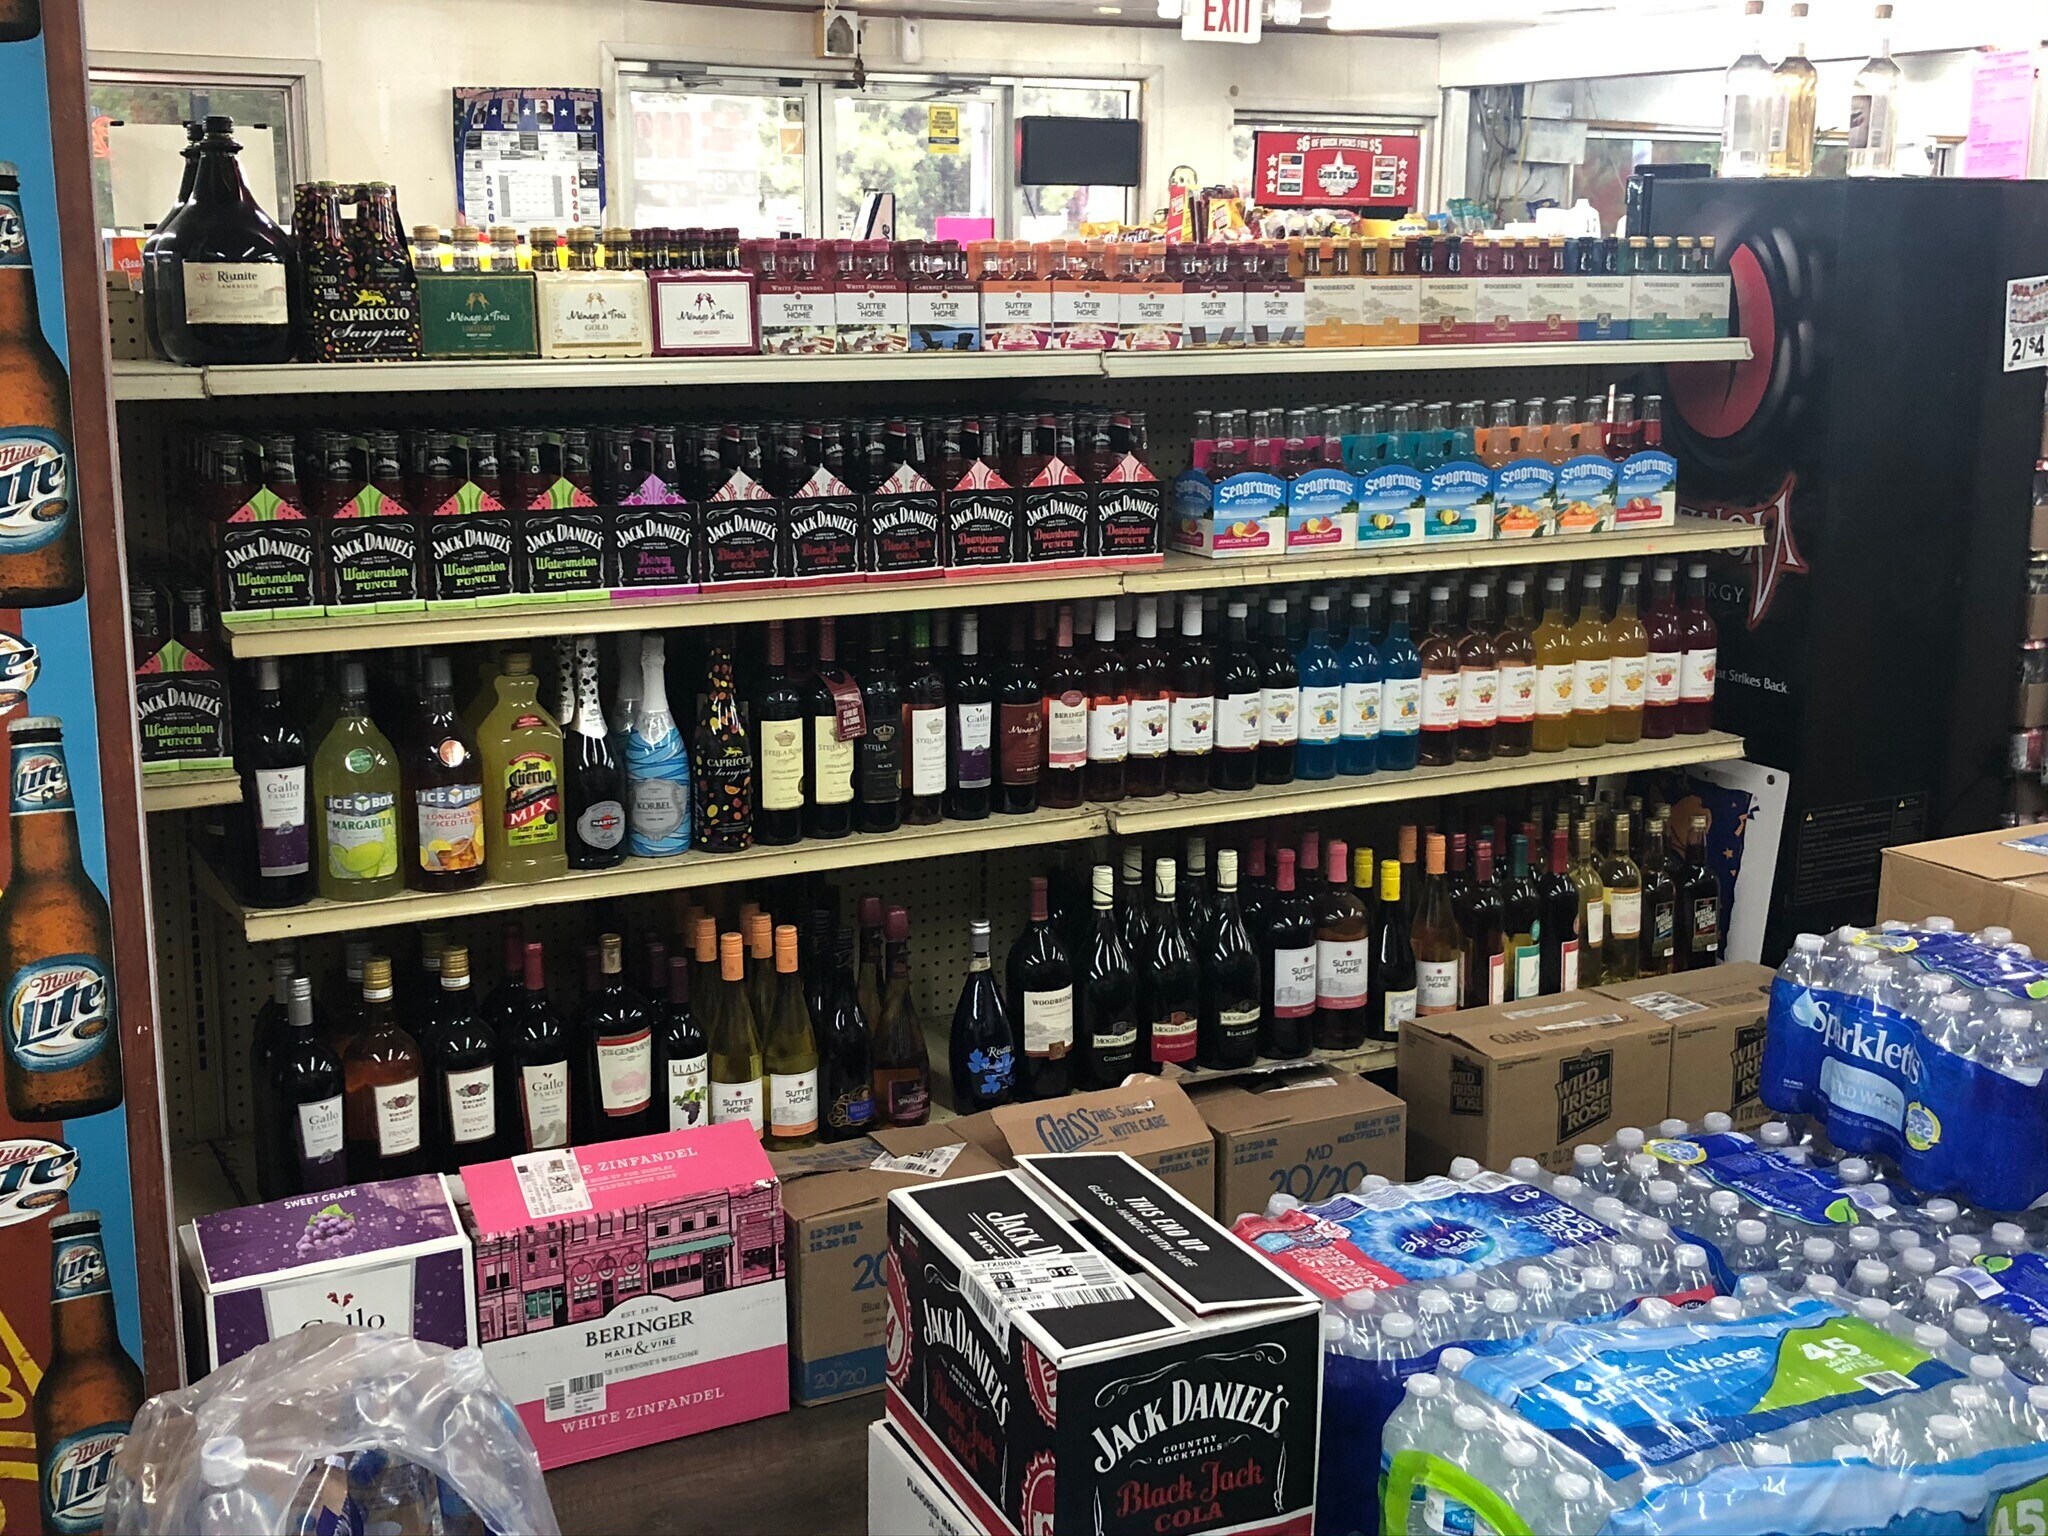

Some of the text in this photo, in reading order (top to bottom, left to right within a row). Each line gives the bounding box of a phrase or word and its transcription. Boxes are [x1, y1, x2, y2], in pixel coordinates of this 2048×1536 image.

[1296, 135, 1310, 152] $6
[1369, 138, 1382, 154] $5
[217, 270, 258, 283] Riunite
[329, 307, 410, 322] CAPRICCIO
[491, 308, 511, 321] Trois
[566, 310, 599, 322] Ménage
[608, 308, 627, 321] Trois
[676, 311, 708, 322] Ménage
[715, 309, 735, 321] Trois
[783, 303, 813, 311] SUTTER
[786, 311, 811, 319] HOME
[857, 302, 887, 310] SUTTER
[860, 310, 884, 318] HOME
[930, 302, 959, 310] SUTTER
[934, 310, 956, 318] HOME
[1004, 301, 1033, 309] SUTTER
[1073, 300, 1100, 309] SUTTER
[1076, 308, 1098, 316] HOME
[1138, 302, 1165, 310] SUTTER
[331, 323, 408, 349] Sangria
[2011, 335, 2046, 361] 2/$4
[1500, 465, 1555, 488] Seagram's
[1560, 463, 1615, 486] Seagram's
[1622, 458, 1674, 480] Seagram's
[1294, 478, 1354, 501] Seagram's
[1364, 473, 1423, 496] Seagram's
[1430, 469, 1489, 492] Seagram's
[1219, 482, 1283, 504] Seagram's
[872, 507, 939, 535] JACK DANIEL'S
[950, 503, 1015, 531] JACK DANIEL'S
[1026, 504, 1050, 527] JACK
[1098, 499, 1122, 521] JACK
[615, 519, 693, 548] JACK DANIEL'S
[706, 514, 778, 544] JACK DANIEL'S
[790, 510, 859, 540] JACK DANIEL'S
[331, 532, 417, 564] JACK DANIEL'S
[431, 529, 513, 560] JACK DANIEL'S
[525, 523, 605, 554] JACK DANIEL'S
[967, 545, 999, 554] PUNCH
[1042, 540, 1074, 549] PUNCH
[224, 536, 314, 569] JACK DANIEL'S
[535, 556, 598, 571] Watermelon
[237, 571, 306, 587] Watermelon
[342, 566, 409, 581] Watermelon
[443, 561, 506, 577] Watermelon
[547, 569, 588, 580] PUNCH
[637, 565, 676, 575] PUNCH
[250, 585, 294, 597] PUNCH
[355, 580, 397, 591] PUNCH
[456, 575, 497, 587] PUNCH
[1728, 669, 1788, 694] Strikes Back
[136, 685, 220, 720] JACK DANIEL'S
[144, 722, 215, 738] Watermelon
[158, 736, 203, 747] PUNCH
[863, 742, 887, 751] STELLA
[16, 762, 65, 800] Lite
[266, 781, 300, 794] Gallo
[509, 769, 552, 788] Cuervo
[328, 793, 394, 809] ICE BOX
[421, 791, 446, 803] ICE
[637, 801, 671, 810] KORBEL
[510, 798, 552, 825] MIX
[332, 816, 393, 830] MARGARITA
[30, 969, 89, 998] Miller
[15, 975, 105, 1052] Lite
[1812, 1000, 1921, 1085] Sparkletts
[531, 1079, 565, 1093] Gallo
[1449, 1069, 1476, 1085] WILD
[1556, 1066, 1600, 1100] WILD
[722, 1097, 754, 1107] SUTTER
[785, 1086, 814, 1098] SUTTER
[1560, 1080, 1610, 1117] IRISH
[308, 1110, 339, 1125] Gallo
[726, 1105, 751, 1114] HOME
[1090, 1107, 1117, 1124] THIS
[1566, 1098, 1611, 1133] ROSE
[1108, 1113, 1170, 1138] WITH CARE
[598, 1146, 699, 1173] ZINFANDEL
[1306, 1143, 1334, 1163] MD
[283, 1188, 358, 1210] SWEET GRAPE
[1509, 1189, 1541, 1203] 40
[985, 1210, 1045, 1249] JACK
[1087, 1183, 1199, 1269] GLASS HANDLE WITH CARE
[1123, 1195, 1211, 1253] THIS END UP
[968, 1230, 996, 1255] BLACK
[56, 1251, 103, 1290] Lite
[1050, 1266, 1078, 1277] 013
[585, 1309, 695, 1348] BERINGER
[604, 1337, 677, 1360] MAIN & VINE
[1686, 1346, 1764, 1373] Water
[1801, 1336, 1862, 1361] 45
[923, 1298, 956, 1350] JACK
[956, 1306, 1011, 1427] DANIEL'S
[560, 1386, 726, 1435] WHITE ZINFANDEL
[1090, 1378, 1290, 1474] JACK DANIEL'S
[1156, 1442, 1224, 1466] COCKTAILS
[1162, 1434, 1218, 1455] COUNTRY
[1116, 1457, 1265, 1518] Black Jack
[1152, 1501, 1224, 1533] COLA
